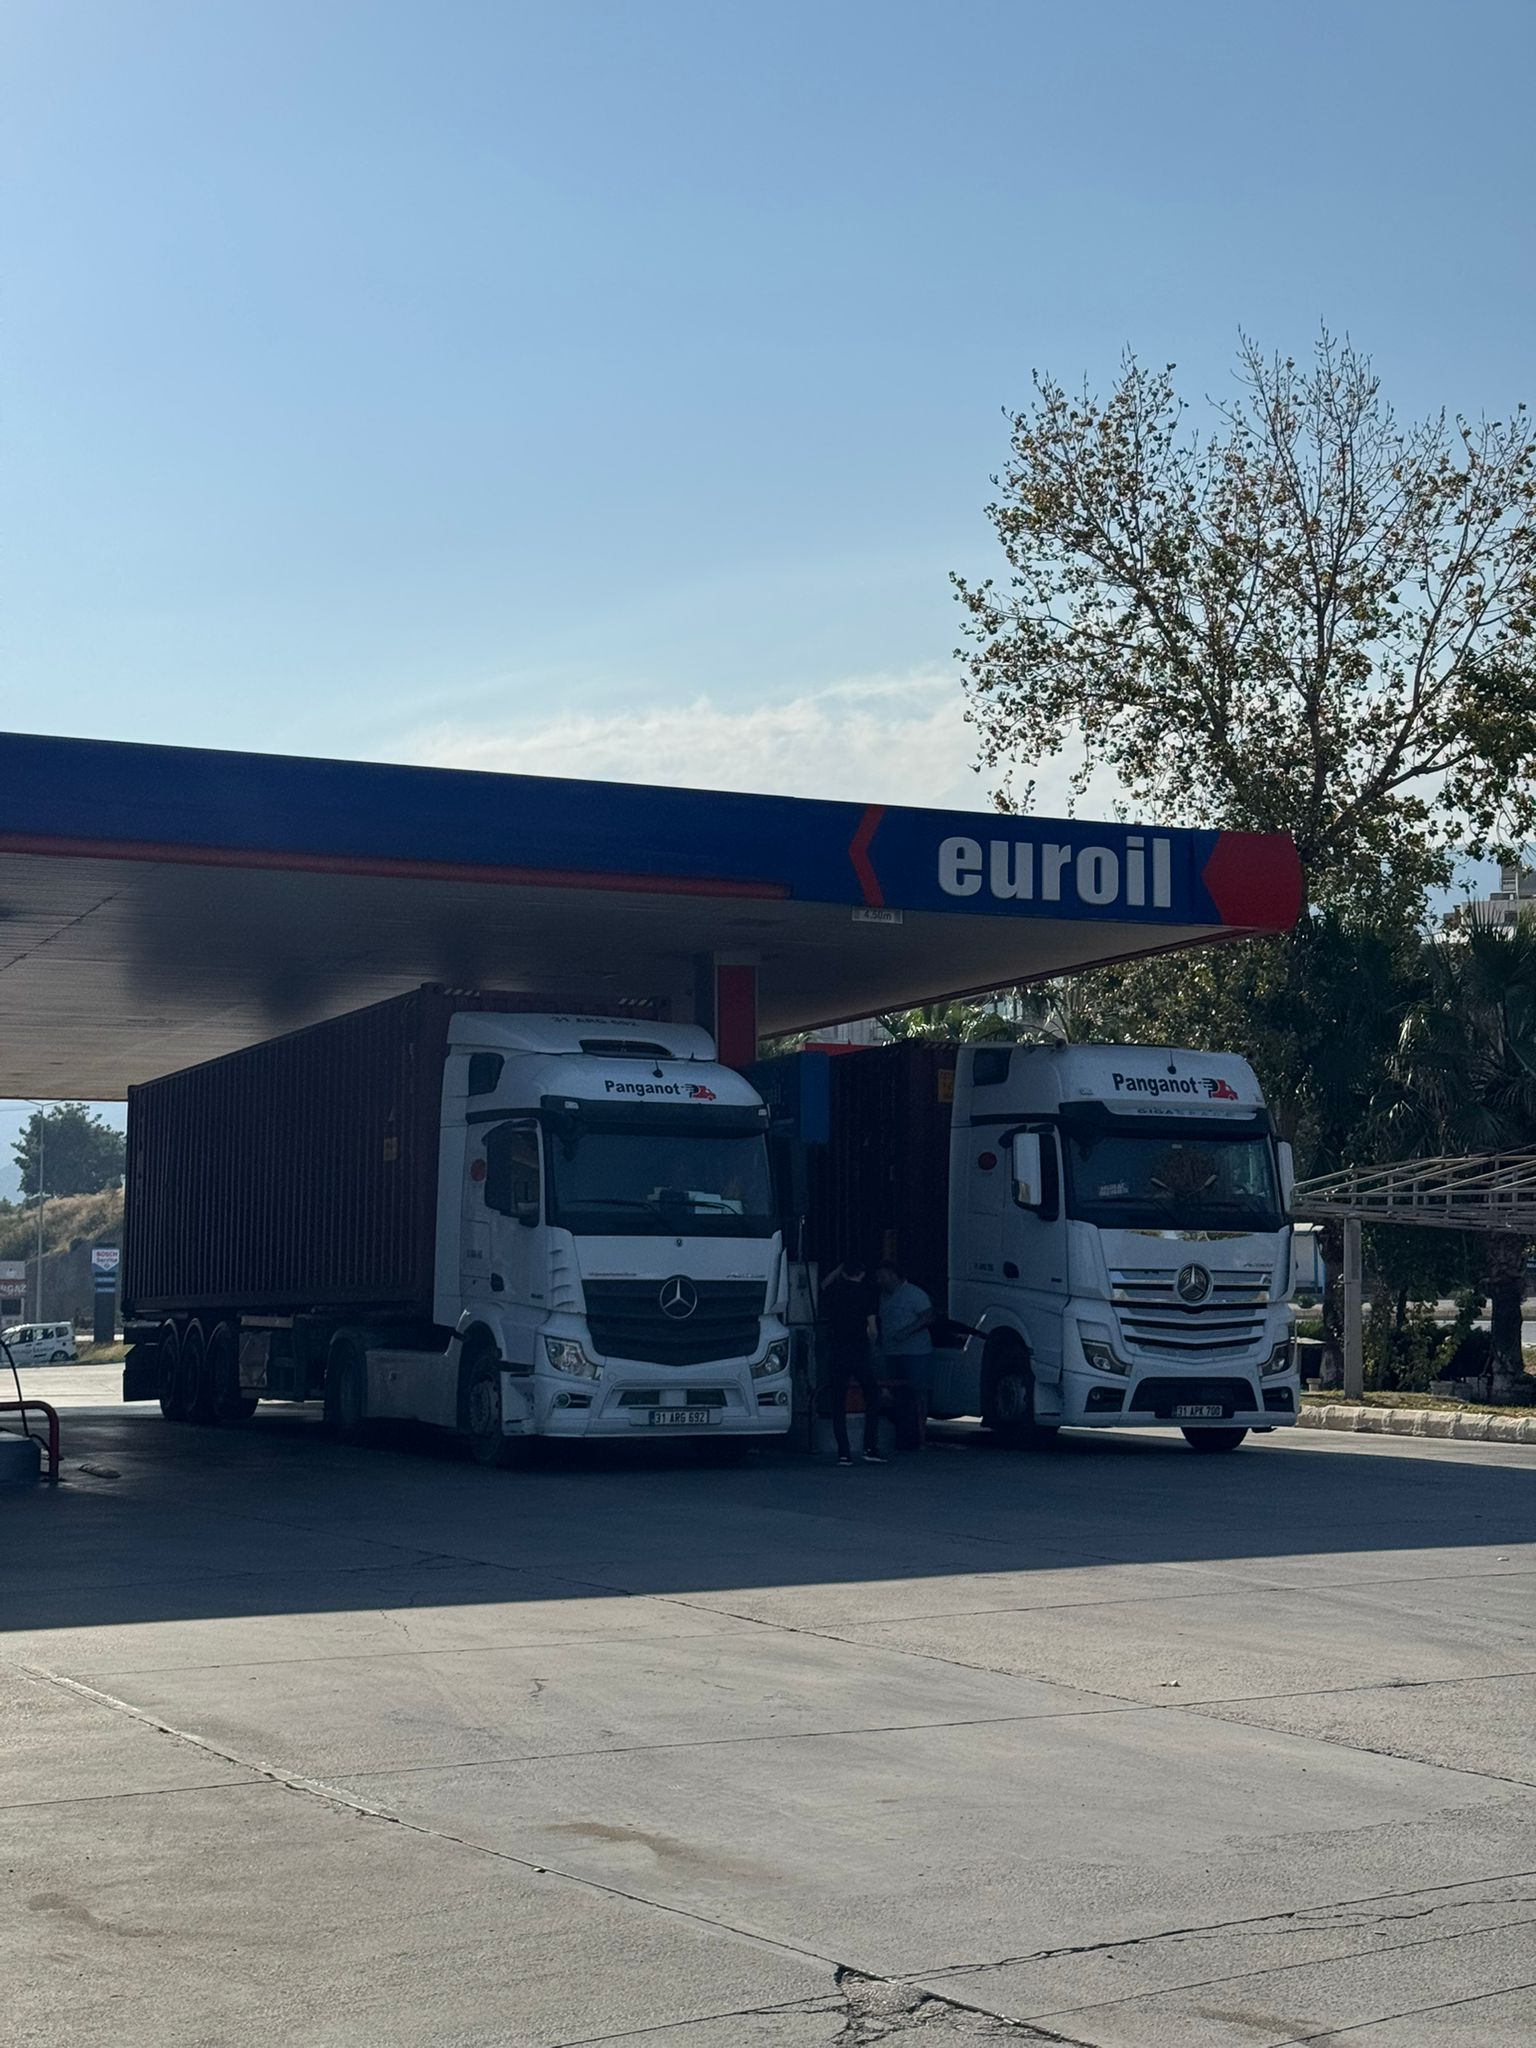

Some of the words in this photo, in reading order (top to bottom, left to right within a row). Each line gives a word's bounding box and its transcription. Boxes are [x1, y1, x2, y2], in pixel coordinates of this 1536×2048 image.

[938, 836, 1171, 908] euroil
[604, 1080, 682, 1097] Panganot
[1112, 1073, 1199, 1097] Panganot
[655, 1413, 666, 1423] 31
[670, 1412, 686, 1423] ARG
